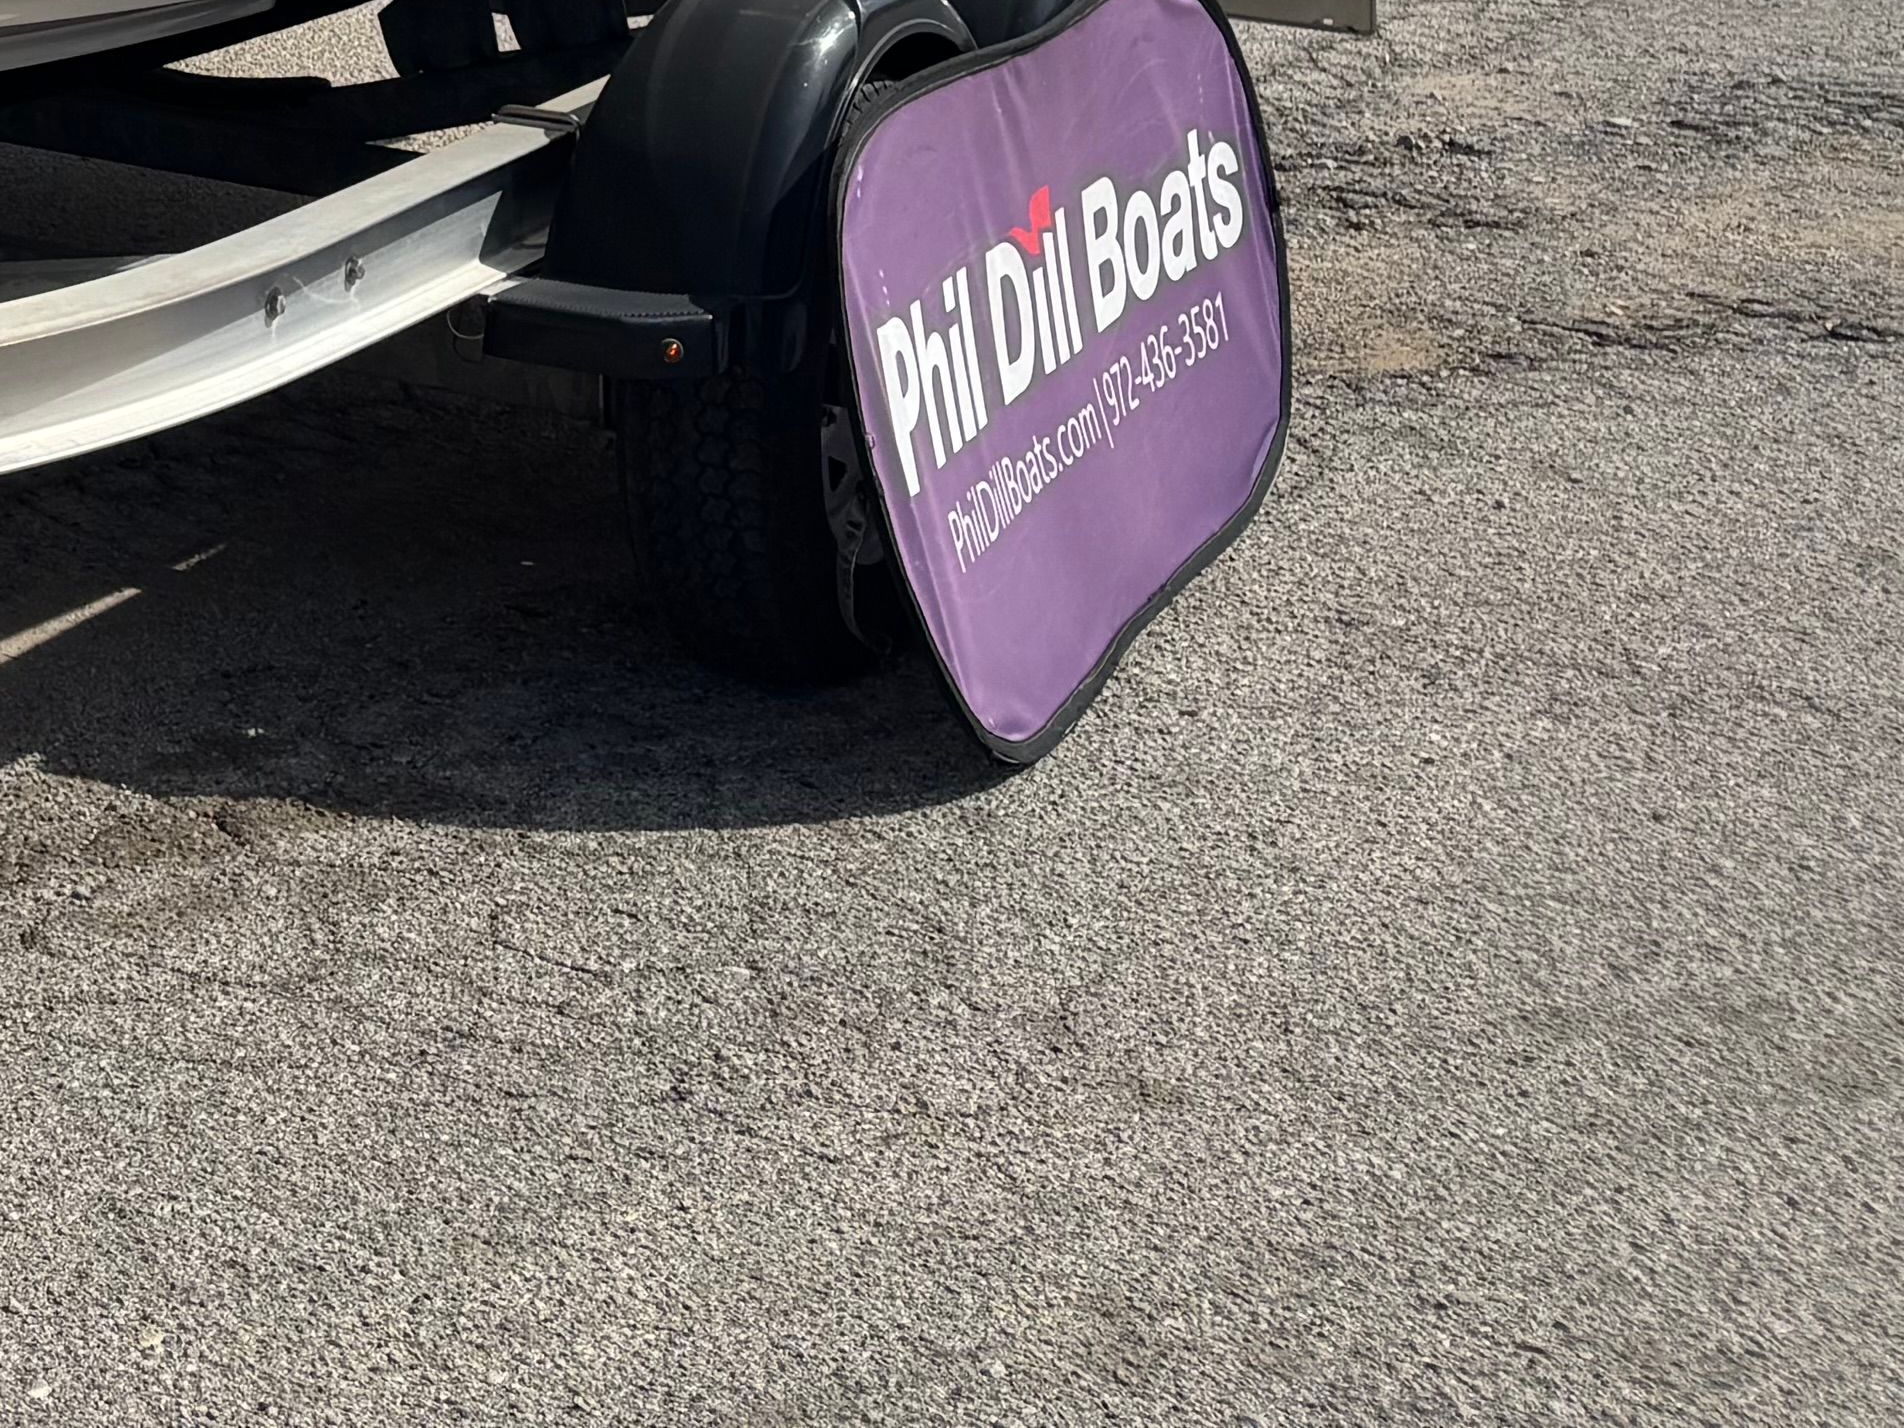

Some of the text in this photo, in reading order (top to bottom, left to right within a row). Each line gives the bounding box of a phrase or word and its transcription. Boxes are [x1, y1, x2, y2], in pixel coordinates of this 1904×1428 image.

[875, 129, 1246, 498] Phil Dill Boats
[947, 401, 1103, 575] PhilDillBoats.com
[1103, 290, 1230, 428] 972-436-3581
